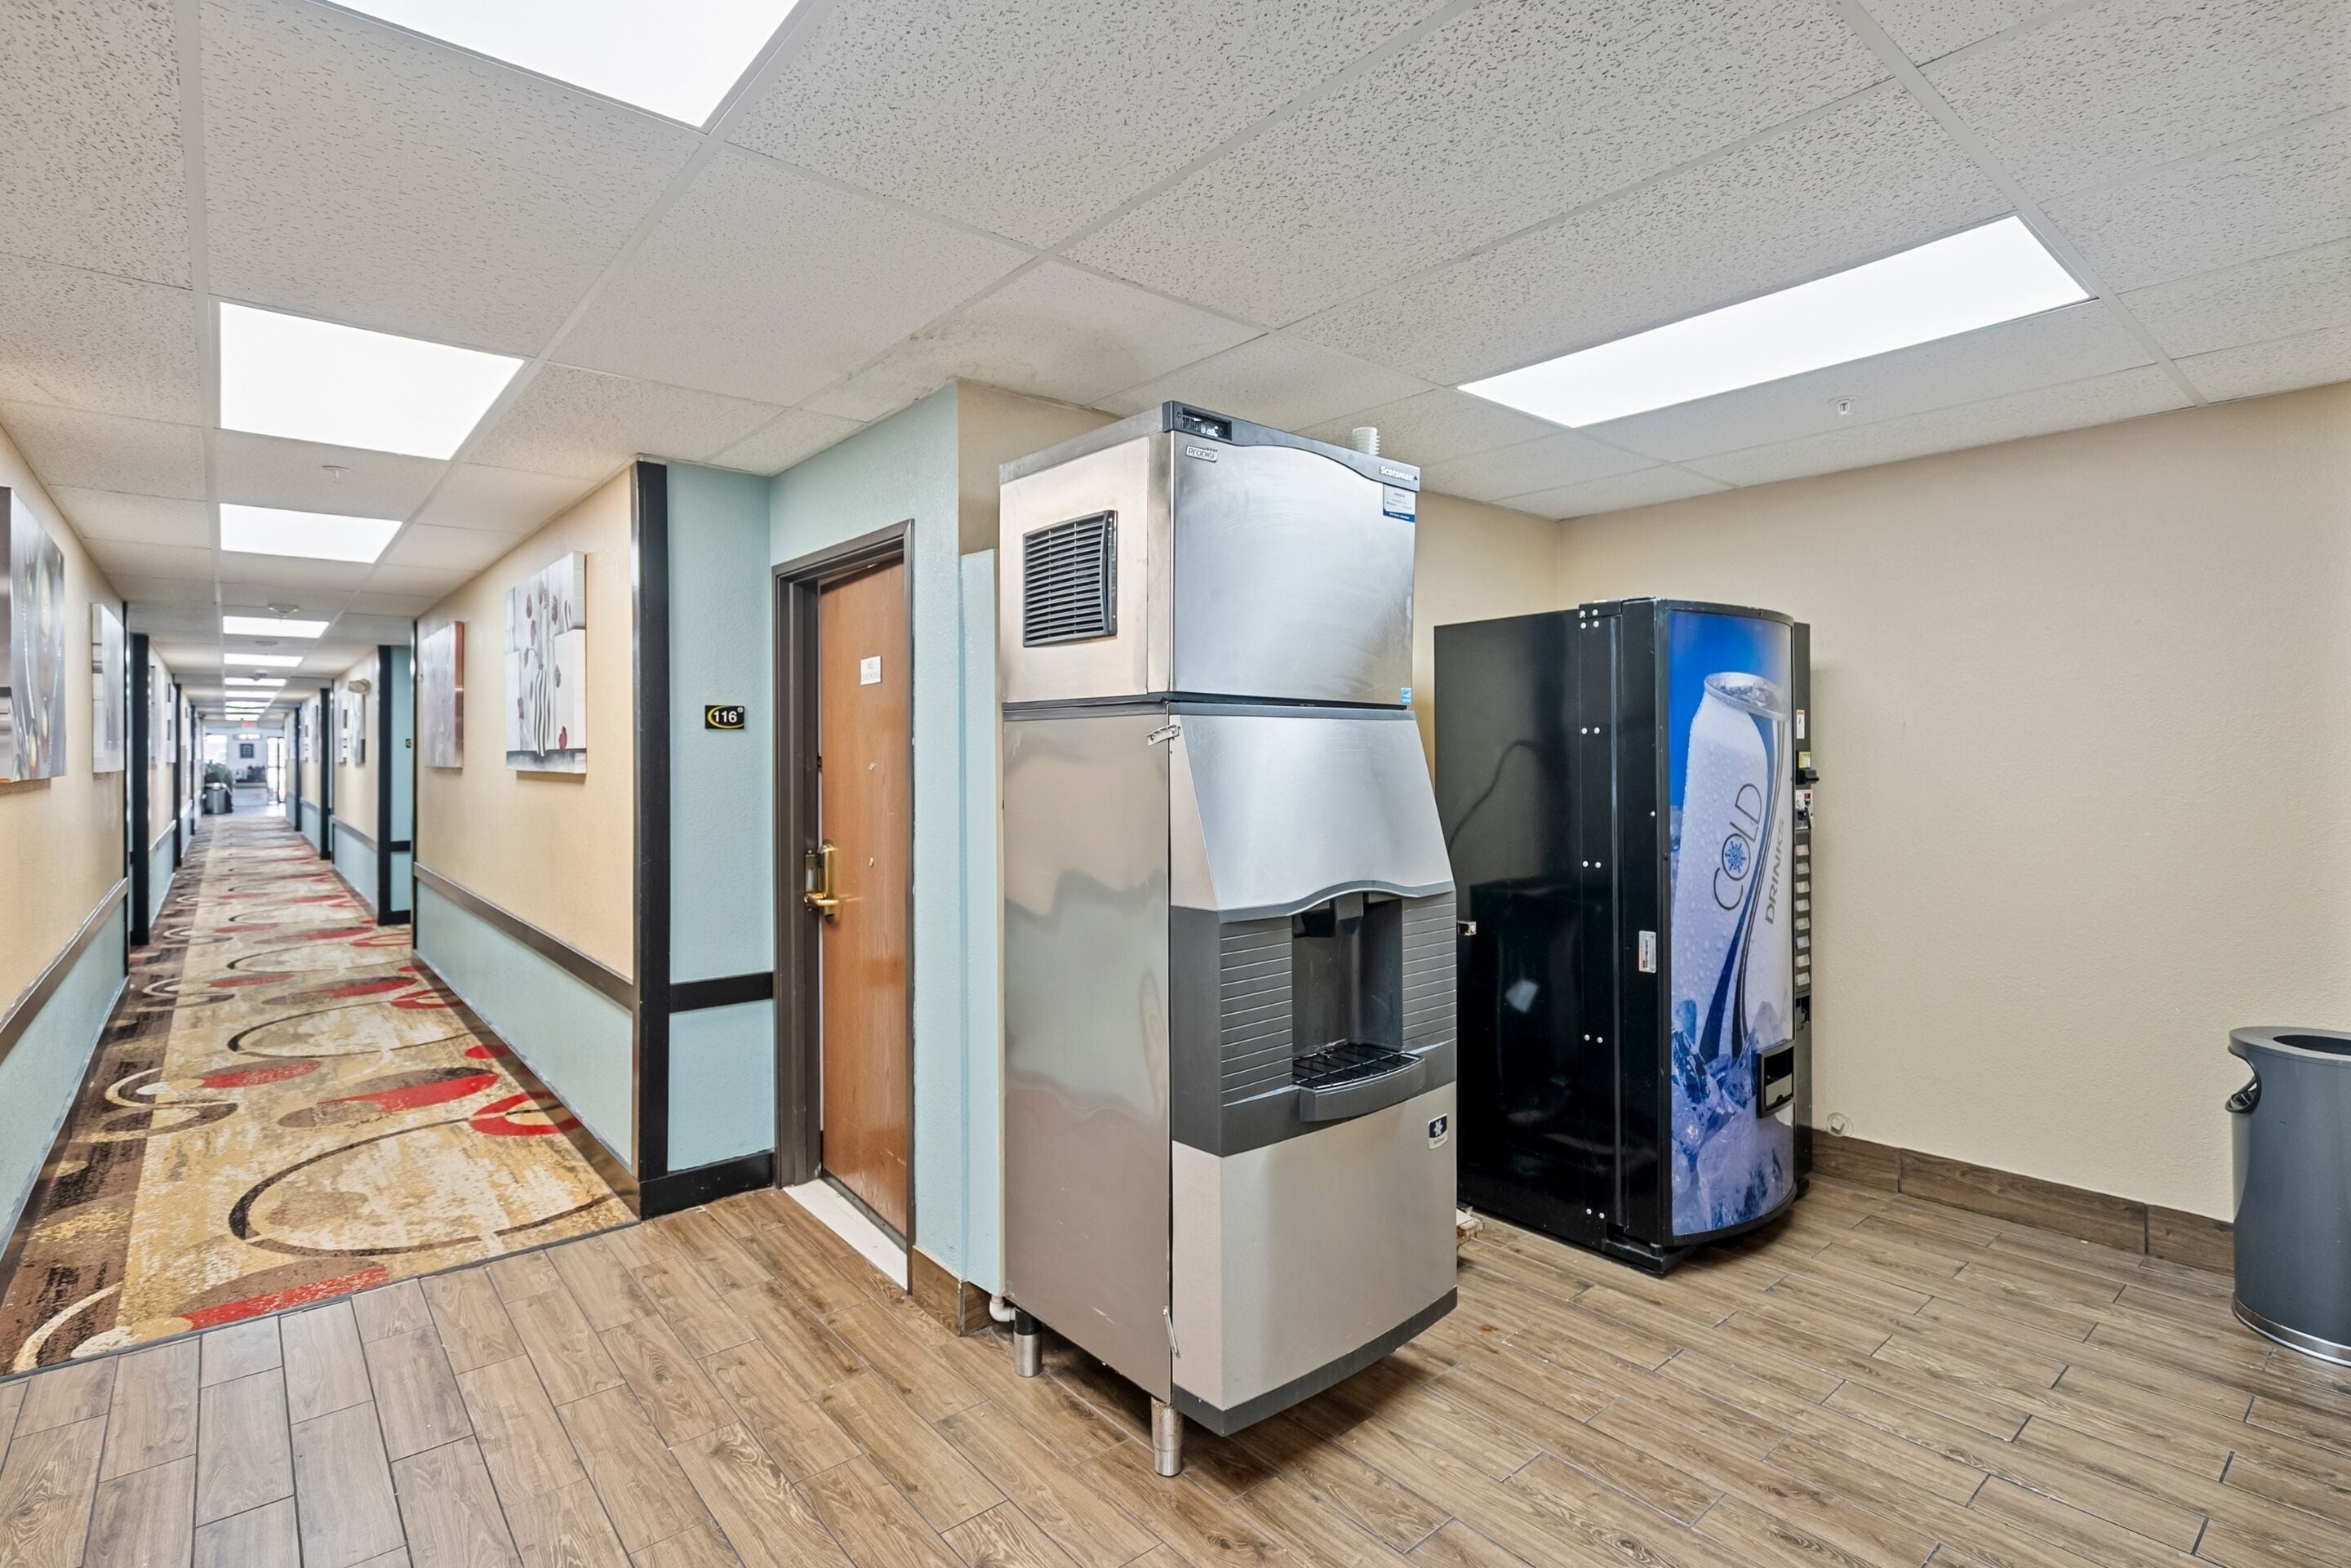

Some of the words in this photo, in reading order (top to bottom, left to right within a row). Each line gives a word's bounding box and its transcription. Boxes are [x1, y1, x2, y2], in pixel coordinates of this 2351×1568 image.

[1380, 465, 1413, 482] Scotsman
[713, 710, 737, 723] 116
[1713, 784, 1762, 910] COLD
[1765, 819, 1784, 925] DRINKS
